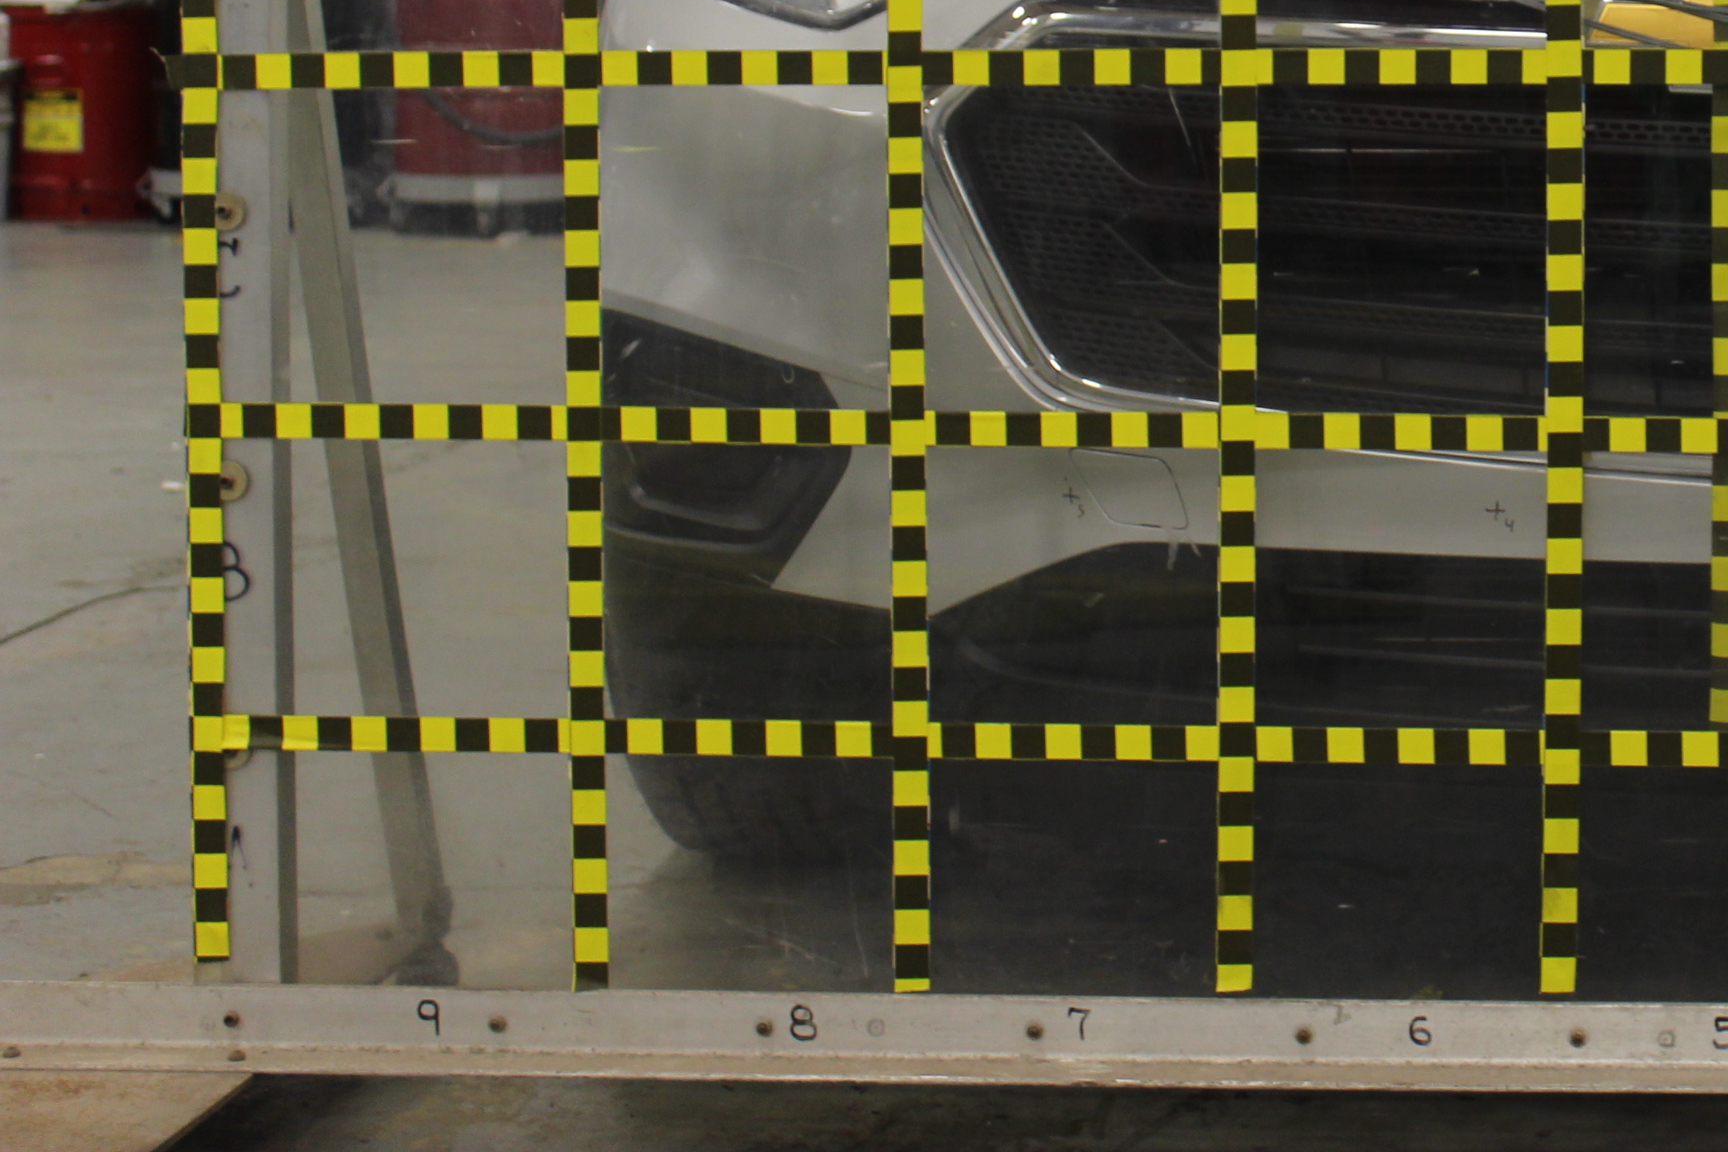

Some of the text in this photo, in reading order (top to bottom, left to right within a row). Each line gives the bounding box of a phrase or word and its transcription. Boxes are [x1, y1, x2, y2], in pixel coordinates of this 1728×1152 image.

[416, 999, 440, 1036] 9
[789, 1004, 817, 1042] 8
[1067, 1006, 1090, 1040] 7
[1408, 1015, 1432, 1046] 6
